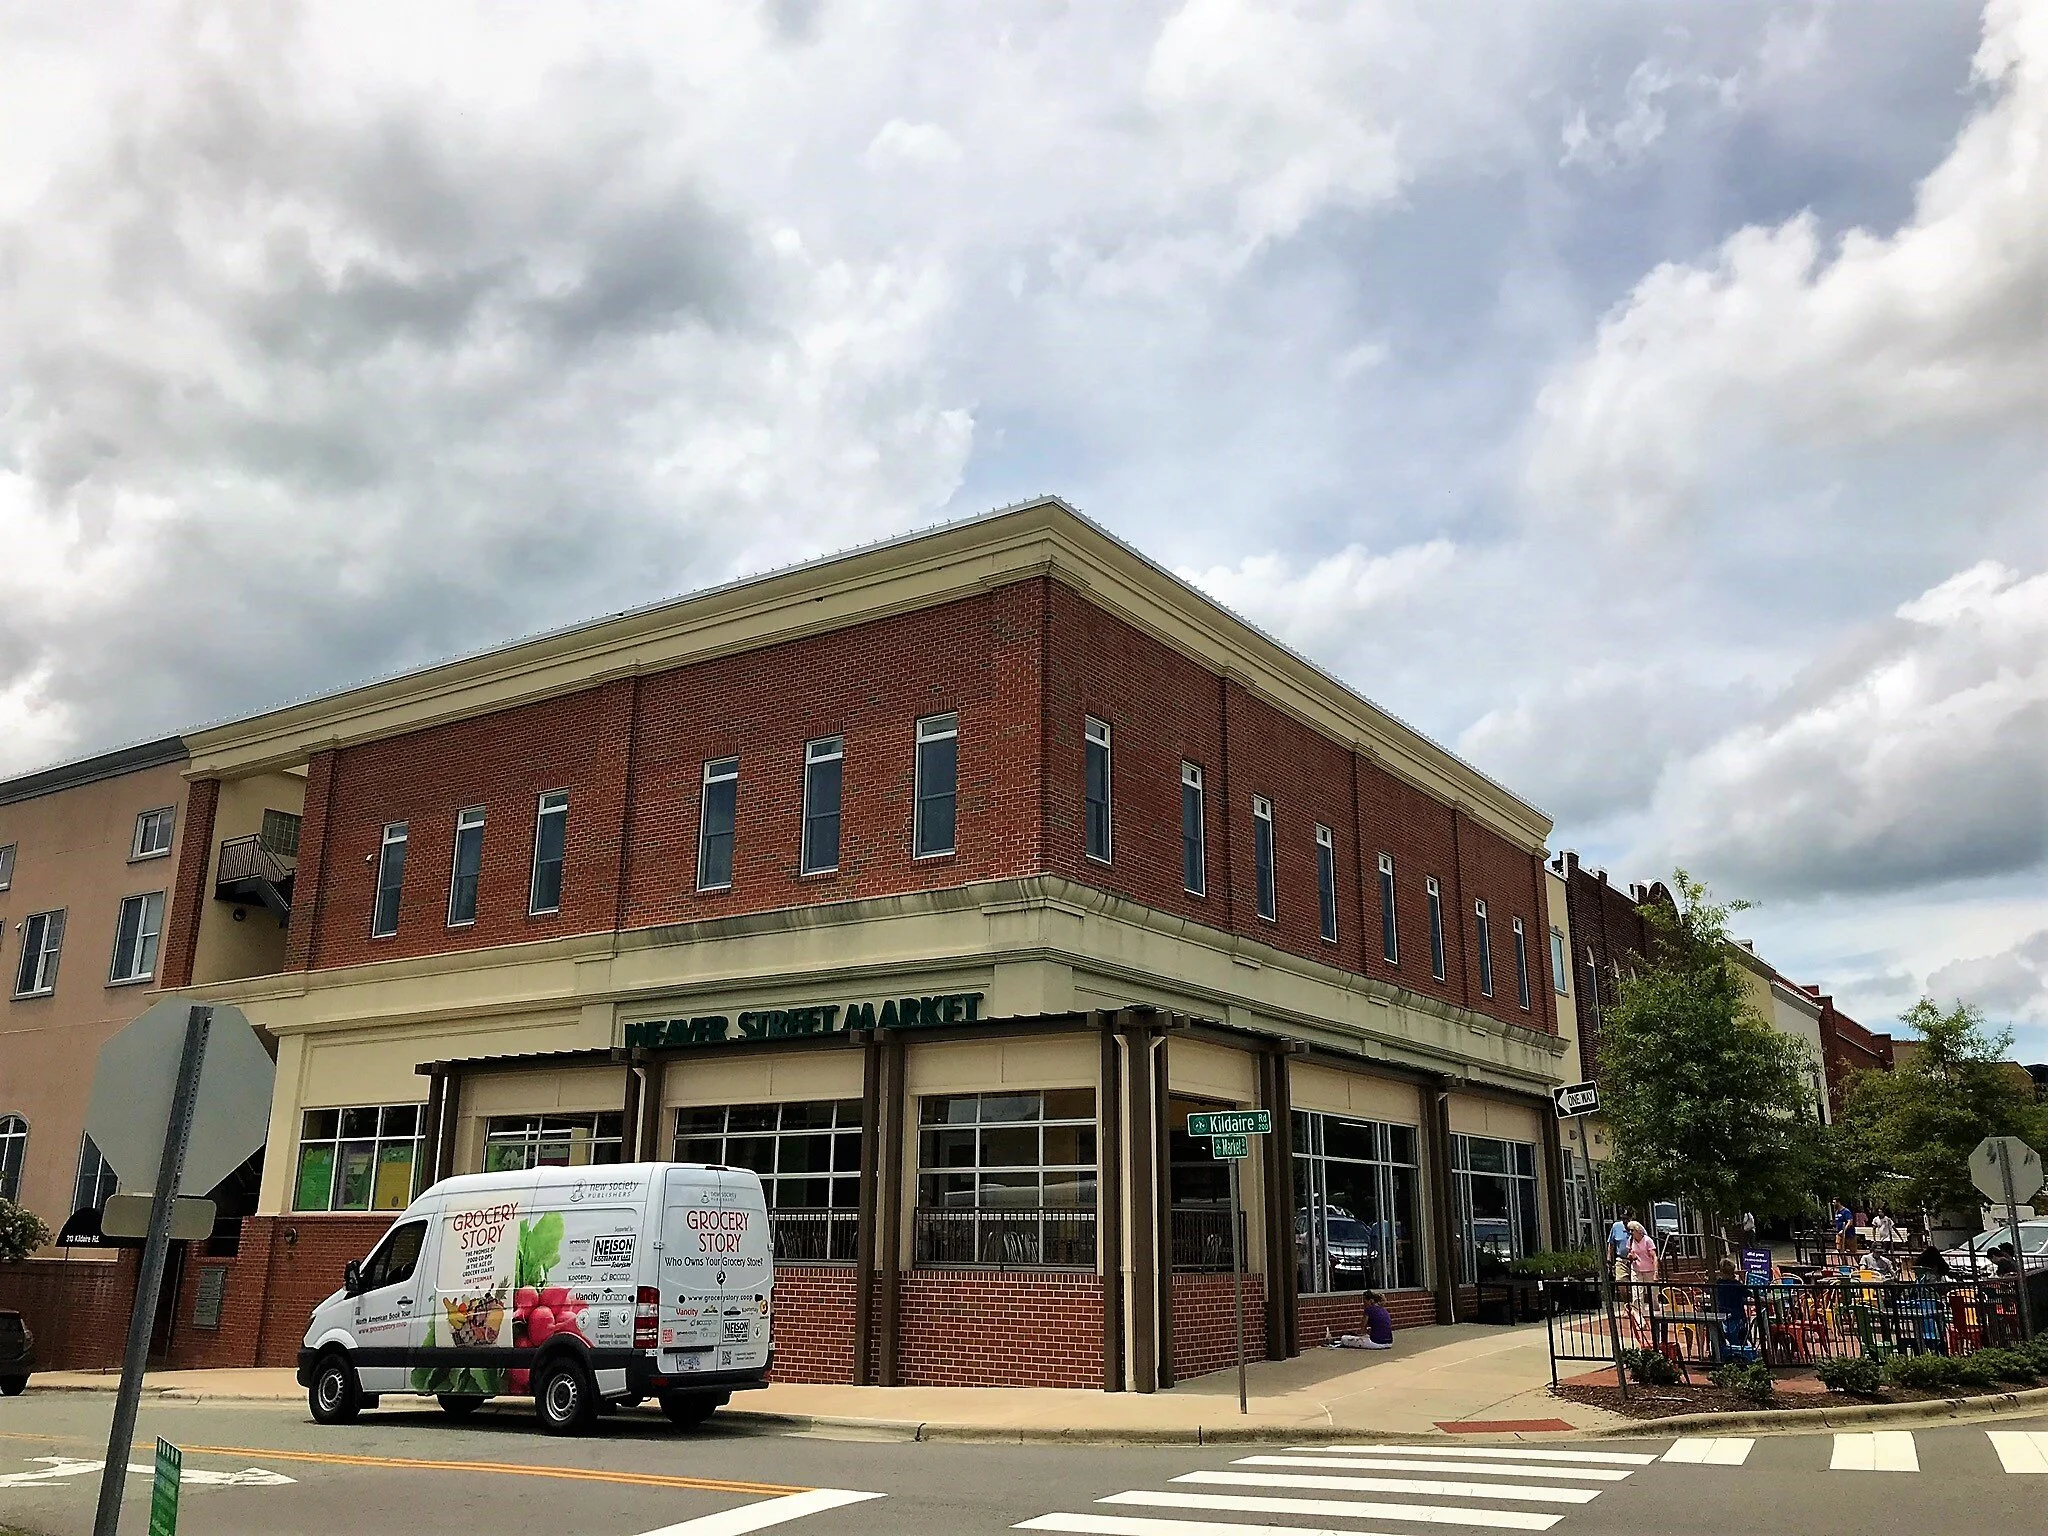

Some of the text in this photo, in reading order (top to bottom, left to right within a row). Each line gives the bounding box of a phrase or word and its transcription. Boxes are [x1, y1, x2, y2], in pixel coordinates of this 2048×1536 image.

[624, 992, 984, 1048] WEAVER STREET MARKET
[1568, 1091, 1593, 1106] ONE WAY
[1210, 1114, 1267, 1132] Kildaire Rd
[1222, 1138, 1242, 1155] Market
[589, 1181, 638, 1192] new society
[453, 1201, 518, 1231] GROCERY
[686, 1210, 749, 1230] GROCERY
[75, 1234, 91, 1242] Kildaire
[461, 1224, 505, 1250] STORY
[699, 1233, 741, 1252] STORY
[473, 1248, 490, 1256] PROMISE
[594, 1239, 633, 1255] NELSON
[665, 1257, 763, 1267] Who Owns Your Grocery Store?
[462, 1269, 480, 1277] GROCERY
[568, 1274, 592, 1282] Kootenay
[575, 1292, 600, 1302] Vancity
[688, 1294, 753, 1303] www.grocerystory.coop
[676, 1307, 698, 1316] Vancity
[725, 1322, 748, 1333] NELSON
